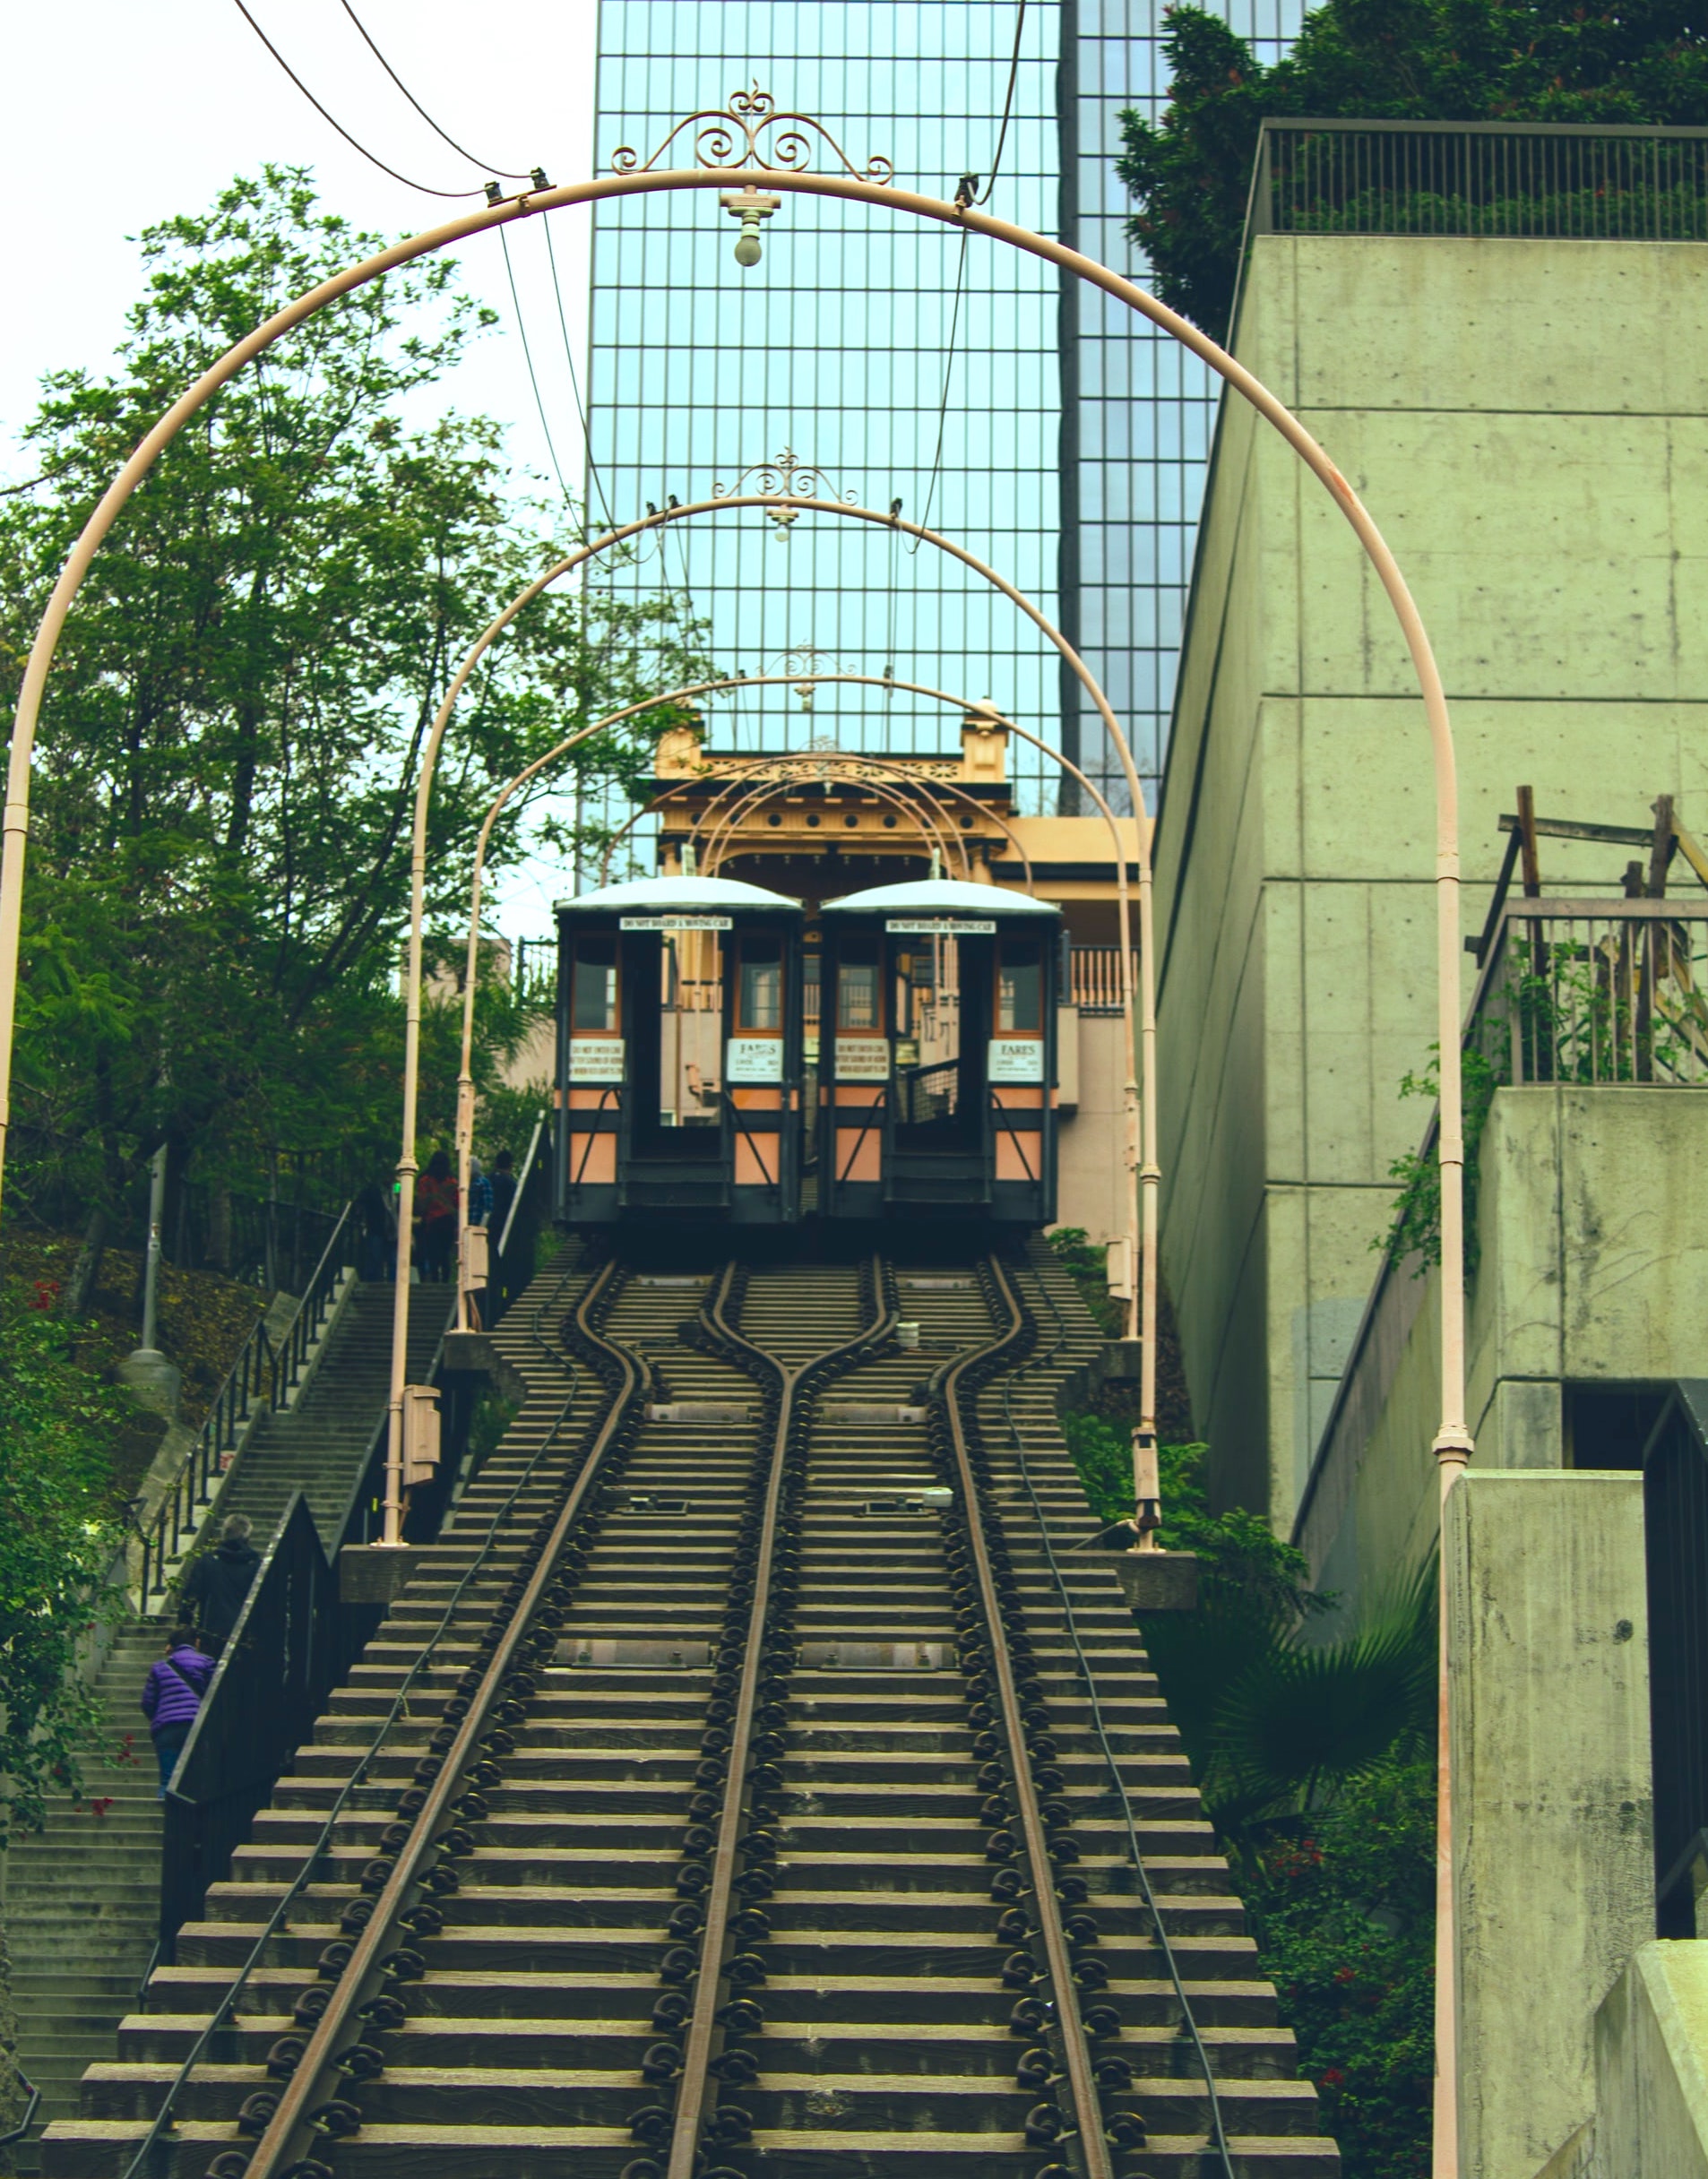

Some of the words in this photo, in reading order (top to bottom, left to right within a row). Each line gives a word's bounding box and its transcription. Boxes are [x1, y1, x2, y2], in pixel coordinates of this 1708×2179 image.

[634, 919, 649, 927] NOT
[685, 919, 712, 927] MOVING
[901, 922, 915, 930] NOT
[950, 923, 976, 931] MOVING
[1001, 1045, 1036, 1055] FARES
